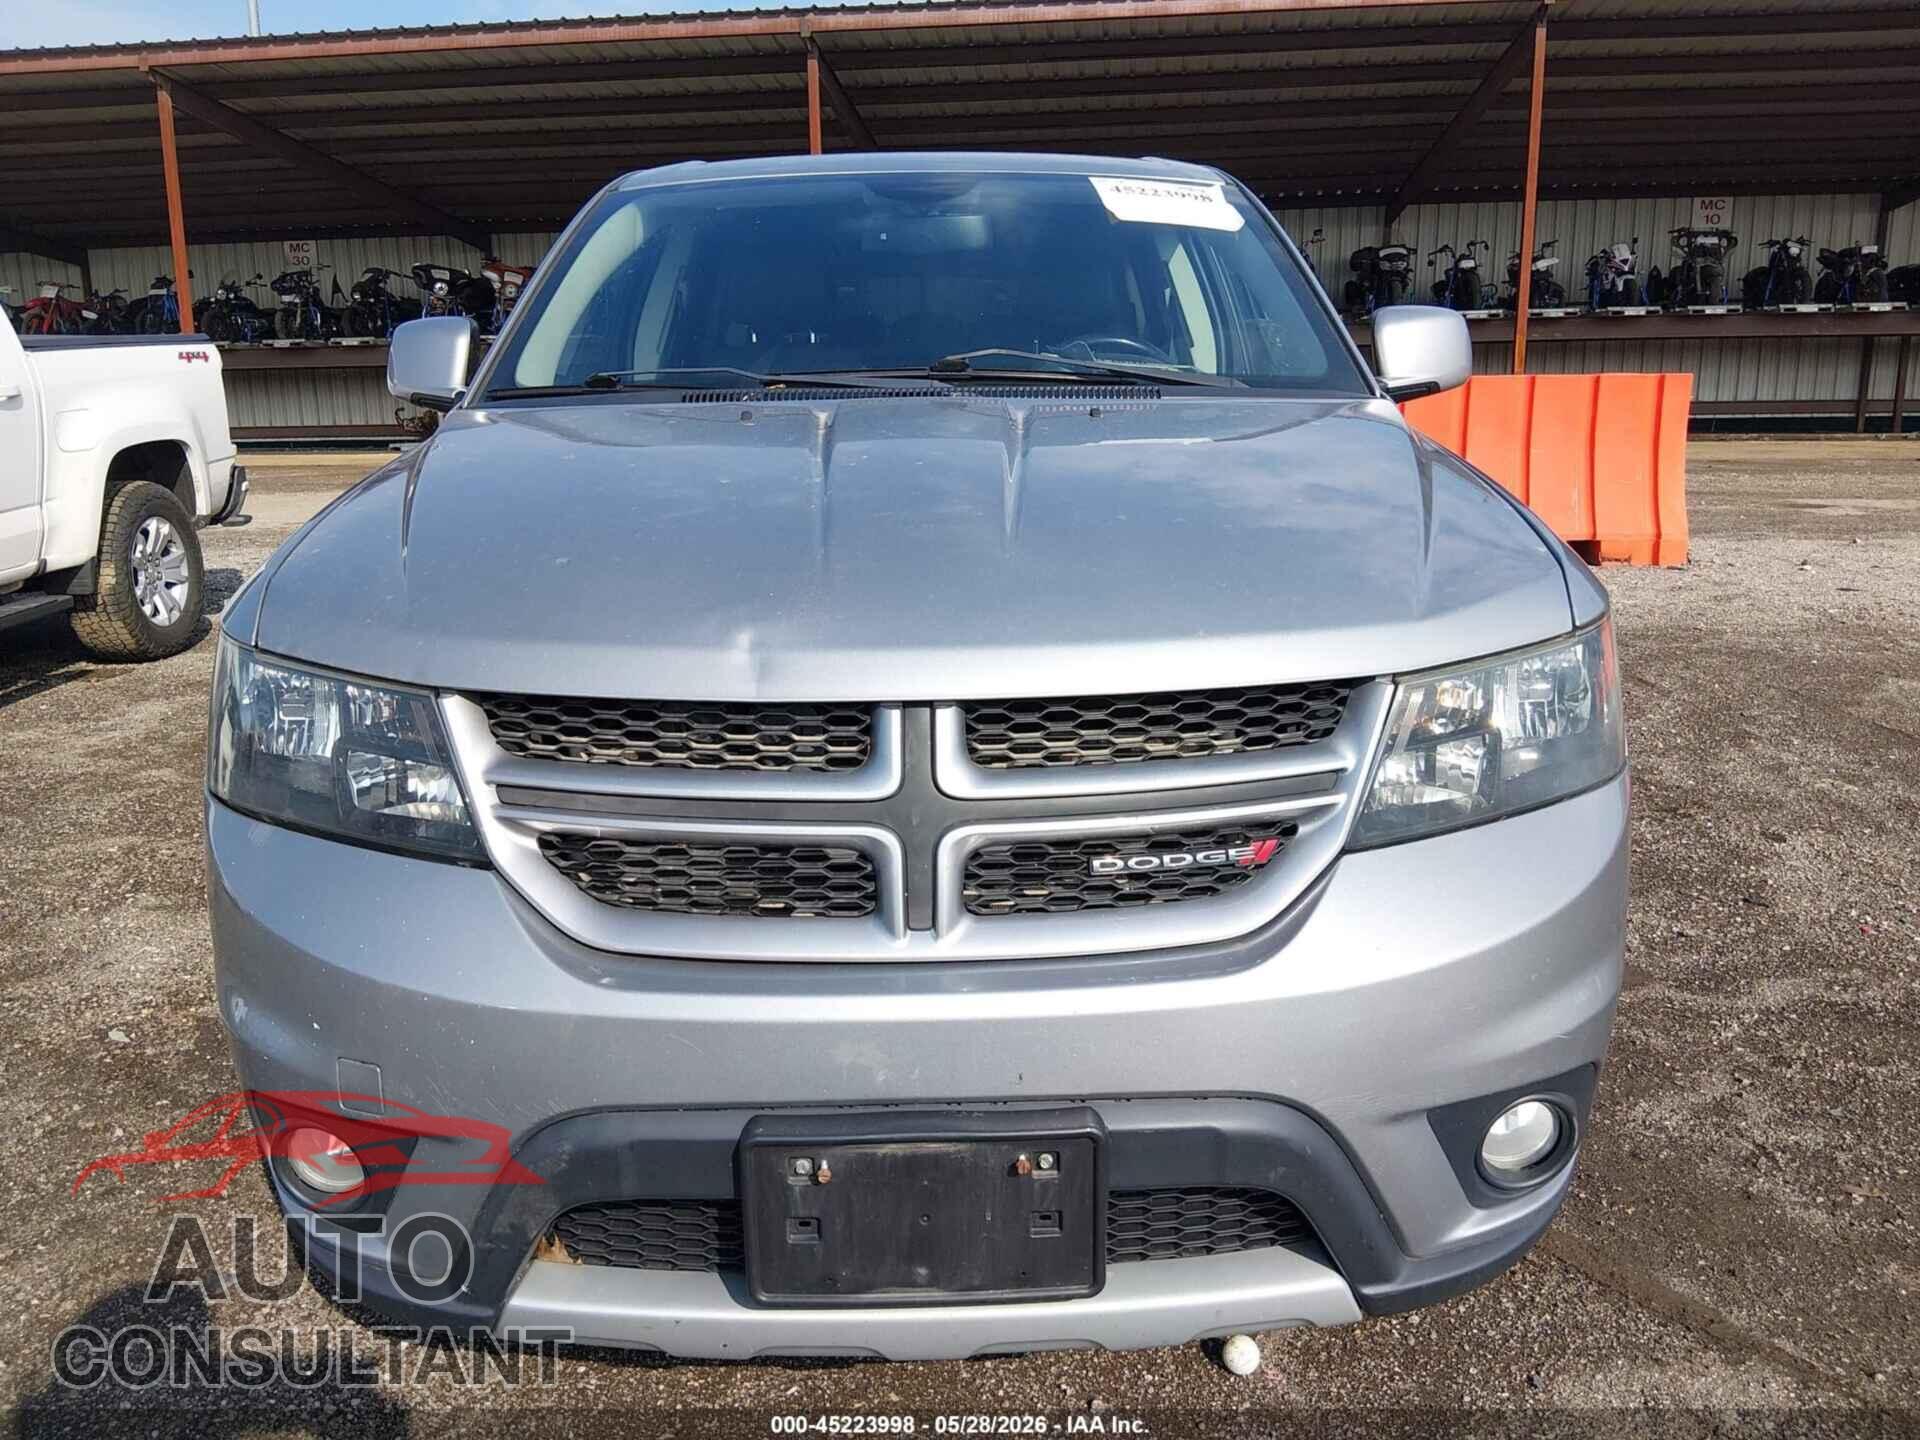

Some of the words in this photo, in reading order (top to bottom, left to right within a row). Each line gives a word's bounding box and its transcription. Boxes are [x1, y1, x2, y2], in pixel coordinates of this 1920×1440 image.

[1700, 199, 1726, 210] MC
[1703, 213, 1721, 225] 10
[289, 242, 310, 253] MC
[292, 255, 310, 266] 30
[1091, 846, 1256, 874] DODGE
